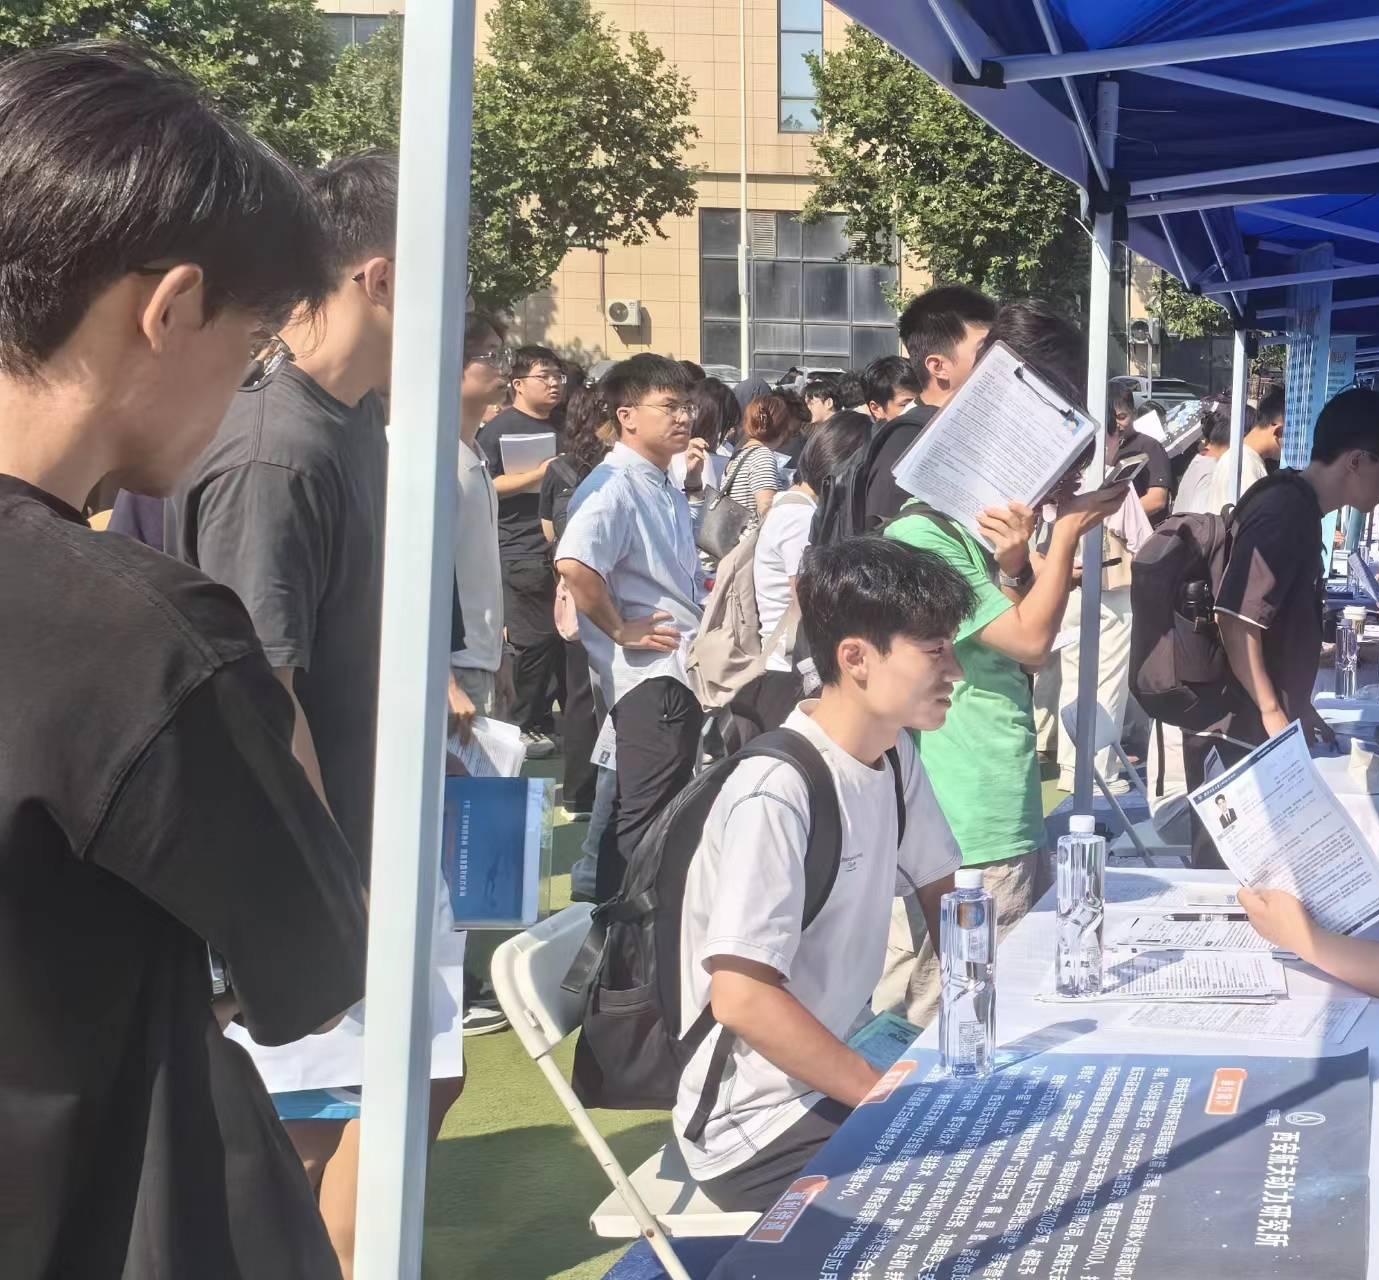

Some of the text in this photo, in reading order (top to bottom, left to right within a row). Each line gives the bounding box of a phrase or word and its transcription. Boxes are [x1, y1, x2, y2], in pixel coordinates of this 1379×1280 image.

[761, 1191, 809, 1231] 福利待遇
[1254, 1131, 1301, 1248] 西安航天动力研究所
